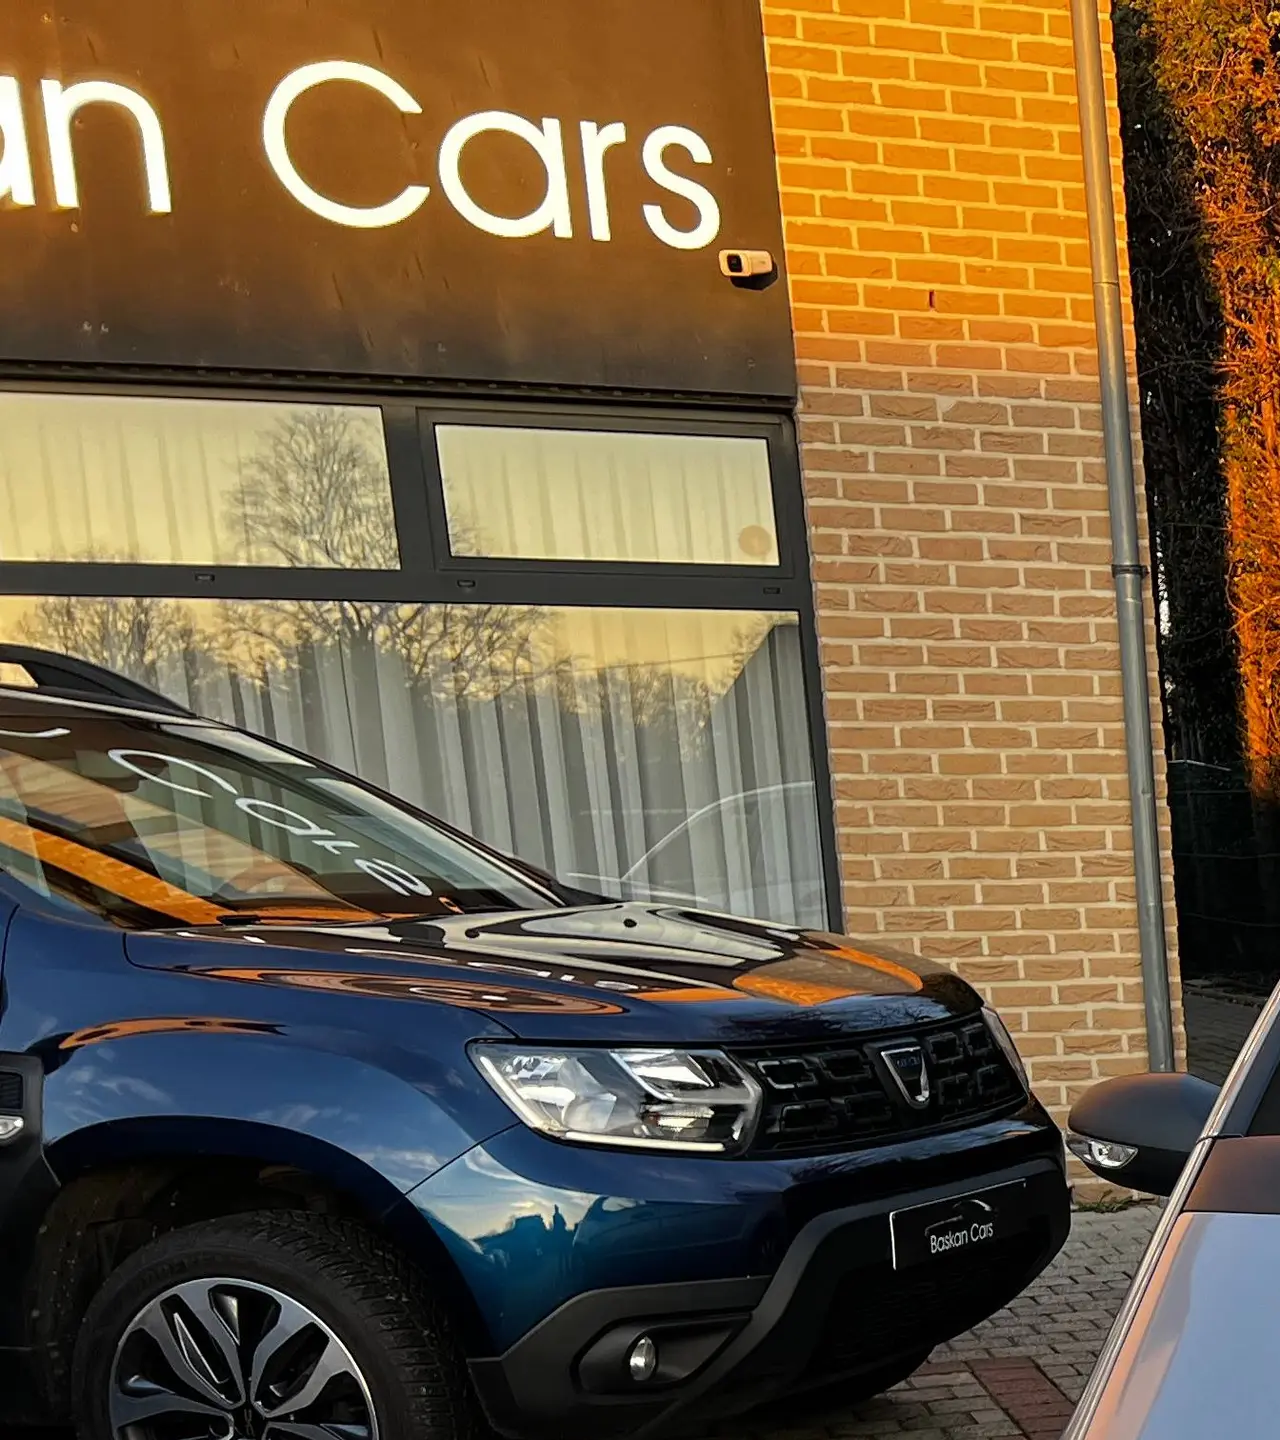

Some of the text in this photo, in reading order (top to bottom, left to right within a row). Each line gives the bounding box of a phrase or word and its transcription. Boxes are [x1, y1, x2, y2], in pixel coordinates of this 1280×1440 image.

[262, 60, 720, 250] Cars
[931, 1222, 994, 1254] Baskan Cars
